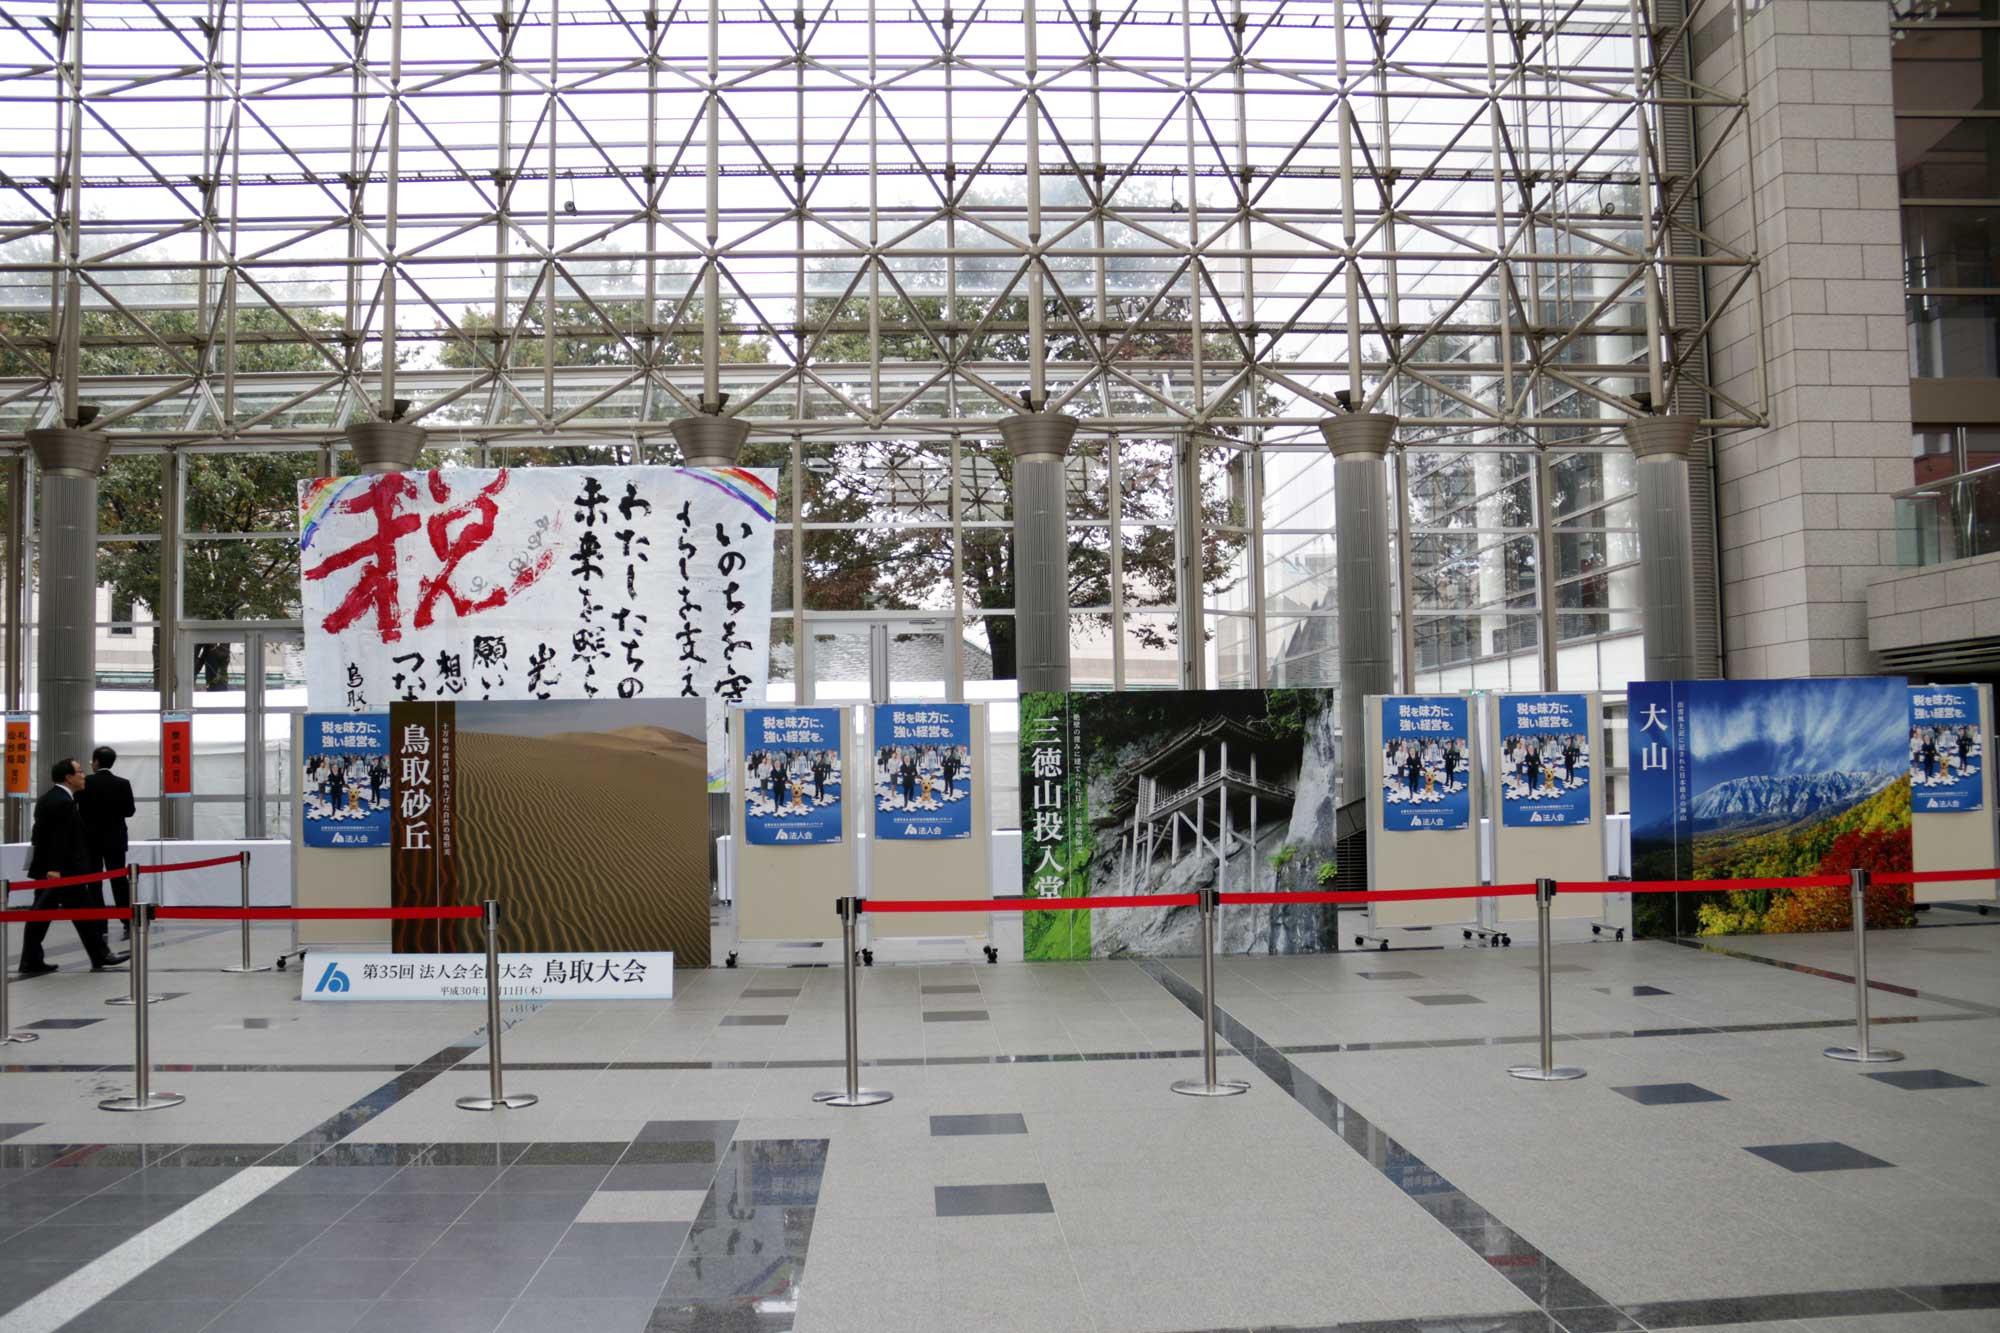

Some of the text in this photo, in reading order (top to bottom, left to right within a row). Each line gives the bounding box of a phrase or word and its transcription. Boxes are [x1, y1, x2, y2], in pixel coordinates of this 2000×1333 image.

[303, 468, 560, 644] 税
[610, 479, 652, 699] わたしたちの
[436, 649, 467, 696] 想
[473, 635, 508, 700] 願い
[527, 642, 562, 700] 光
[346, 661, 367, 711] 鳥取
[1399, 704, 1454, 718] 税を味方に、
[1517, 702, 1574, 715] 税を味方に、
[763, 716, 824, 729] 税を味方に、
[893, 711, 954, 724] 税を味方に、
[1517, 716, 1574, 729] 強い経営を。
[321, 720, 382, 734] 税を味方に、
[893, 725, 954, 738] 強い経営を。
[1399, 719, 1454, 731] 強い経営を。
[321, 735, 382, 748] 強い経営を。
[763, 730, 824, 743] 強い経営を。
[1639, 703, 1668, 771] 大山
[401, 724, 432, 849] 鳥取砂丘
[1031, 716, 1064, 900] 三徳山投入堂
[1939, 800, 1960, 808] 法人会
[1422, 818, 1444, 826] 法人会
[1542, 813, 1565, 822] 法人会
[789, 831, 812, 840] 法人会
[918, 826, 941, 835] 法人会
[344, 833, 369, 843] 法人会
[363, 959, 648, 984] 第35回 法人会全大会 鳥取大会
[440, 985, 544, 996] 平成30年111日(木)
